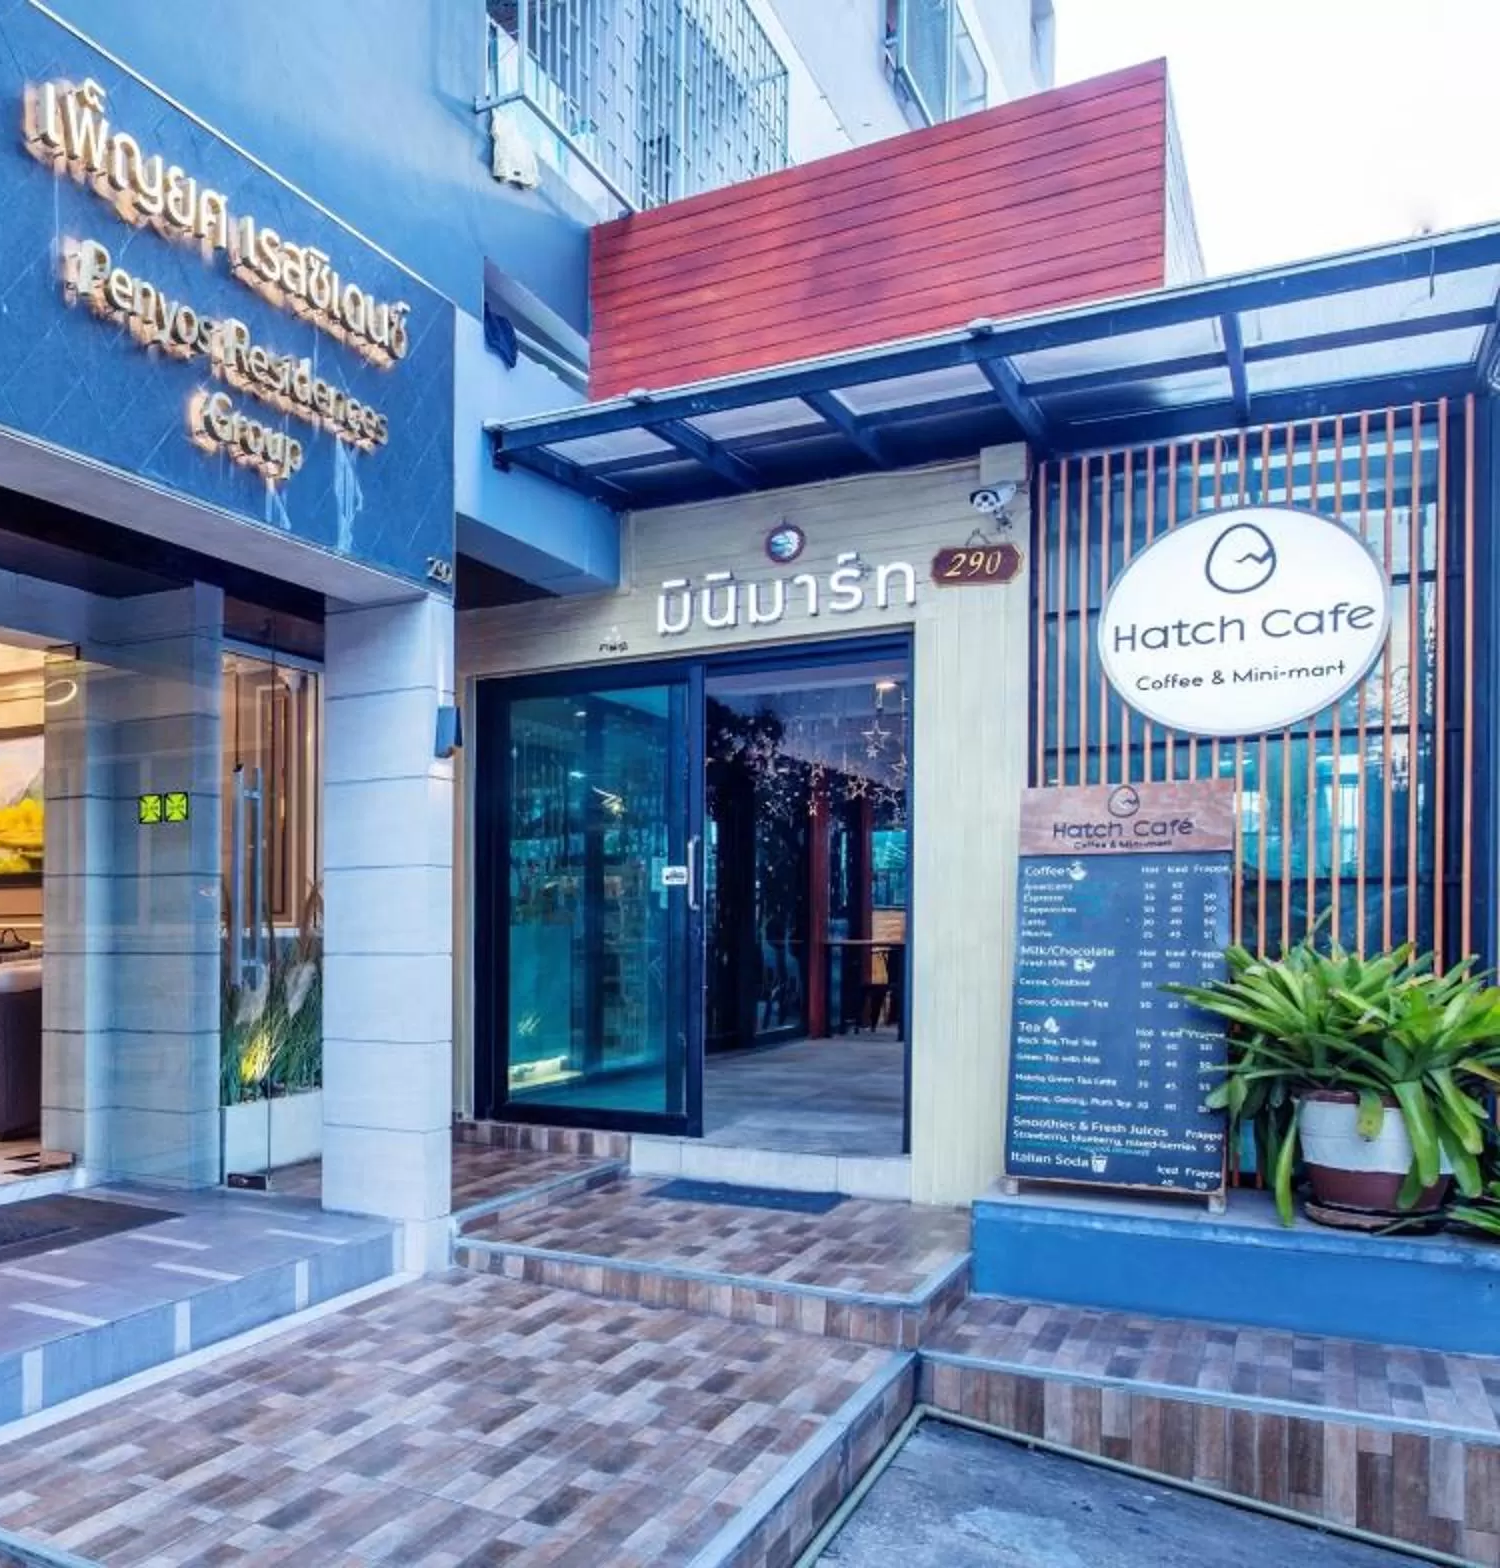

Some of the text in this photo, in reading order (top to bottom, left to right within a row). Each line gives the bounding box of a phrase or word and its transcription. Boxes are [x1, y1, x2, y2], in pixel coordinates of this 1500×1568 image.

[76, 238, 389, 446] Penyos Residences
[201, 391, 303, 481] Group
[943, 552, 1002, 578] 290
[656, 551, 917, 636] มินิมาร์ท
[1113, 602, 1377, 653] Hatch Cafe
[1135, 659, 1347, 691] Coffee & Mini-mart
[1053, 818, 1194, 839] Hatch Café
[1073, 841, 1107, 850] Coffee
[1109, 840, 1118, 849] &
[1024, 864, 1066, 877] Coffee
[1167, 865, 1189, 874] Iced
[1193, 864, 1230, 876] Frappe
[1017, 1021, 1042, 1033] Tea
[1013, 1115, 1224, 1141] Smoothies & Fresh Juices Frappe
[1011, 1151, 1223, 1180] Italian Soda Iced Frappe
